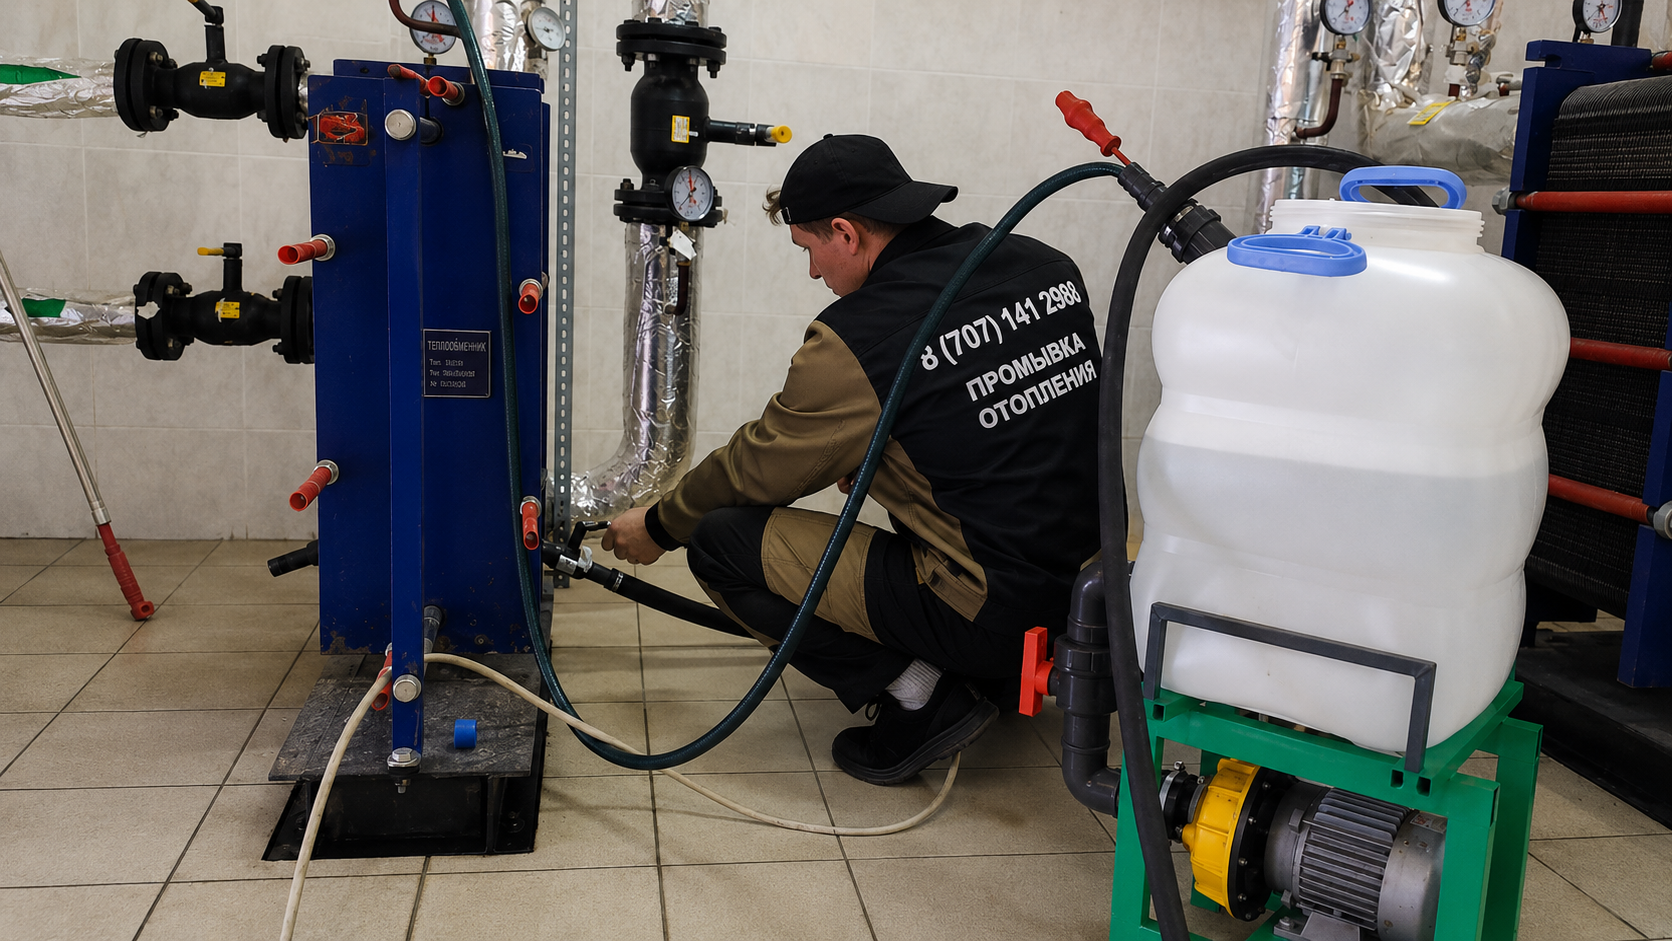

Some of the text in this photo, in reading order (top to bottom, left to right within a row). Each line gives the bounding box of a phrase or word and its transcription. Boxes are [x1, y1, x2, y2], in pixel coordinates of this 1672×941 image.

[920, 280, 1082, 371] 8 (707) 141 2988
[965, 332, 1087, 402] ПРОМЫВКА
[978, 359, 1098, 429] ОТОПЛЕНИЯ
